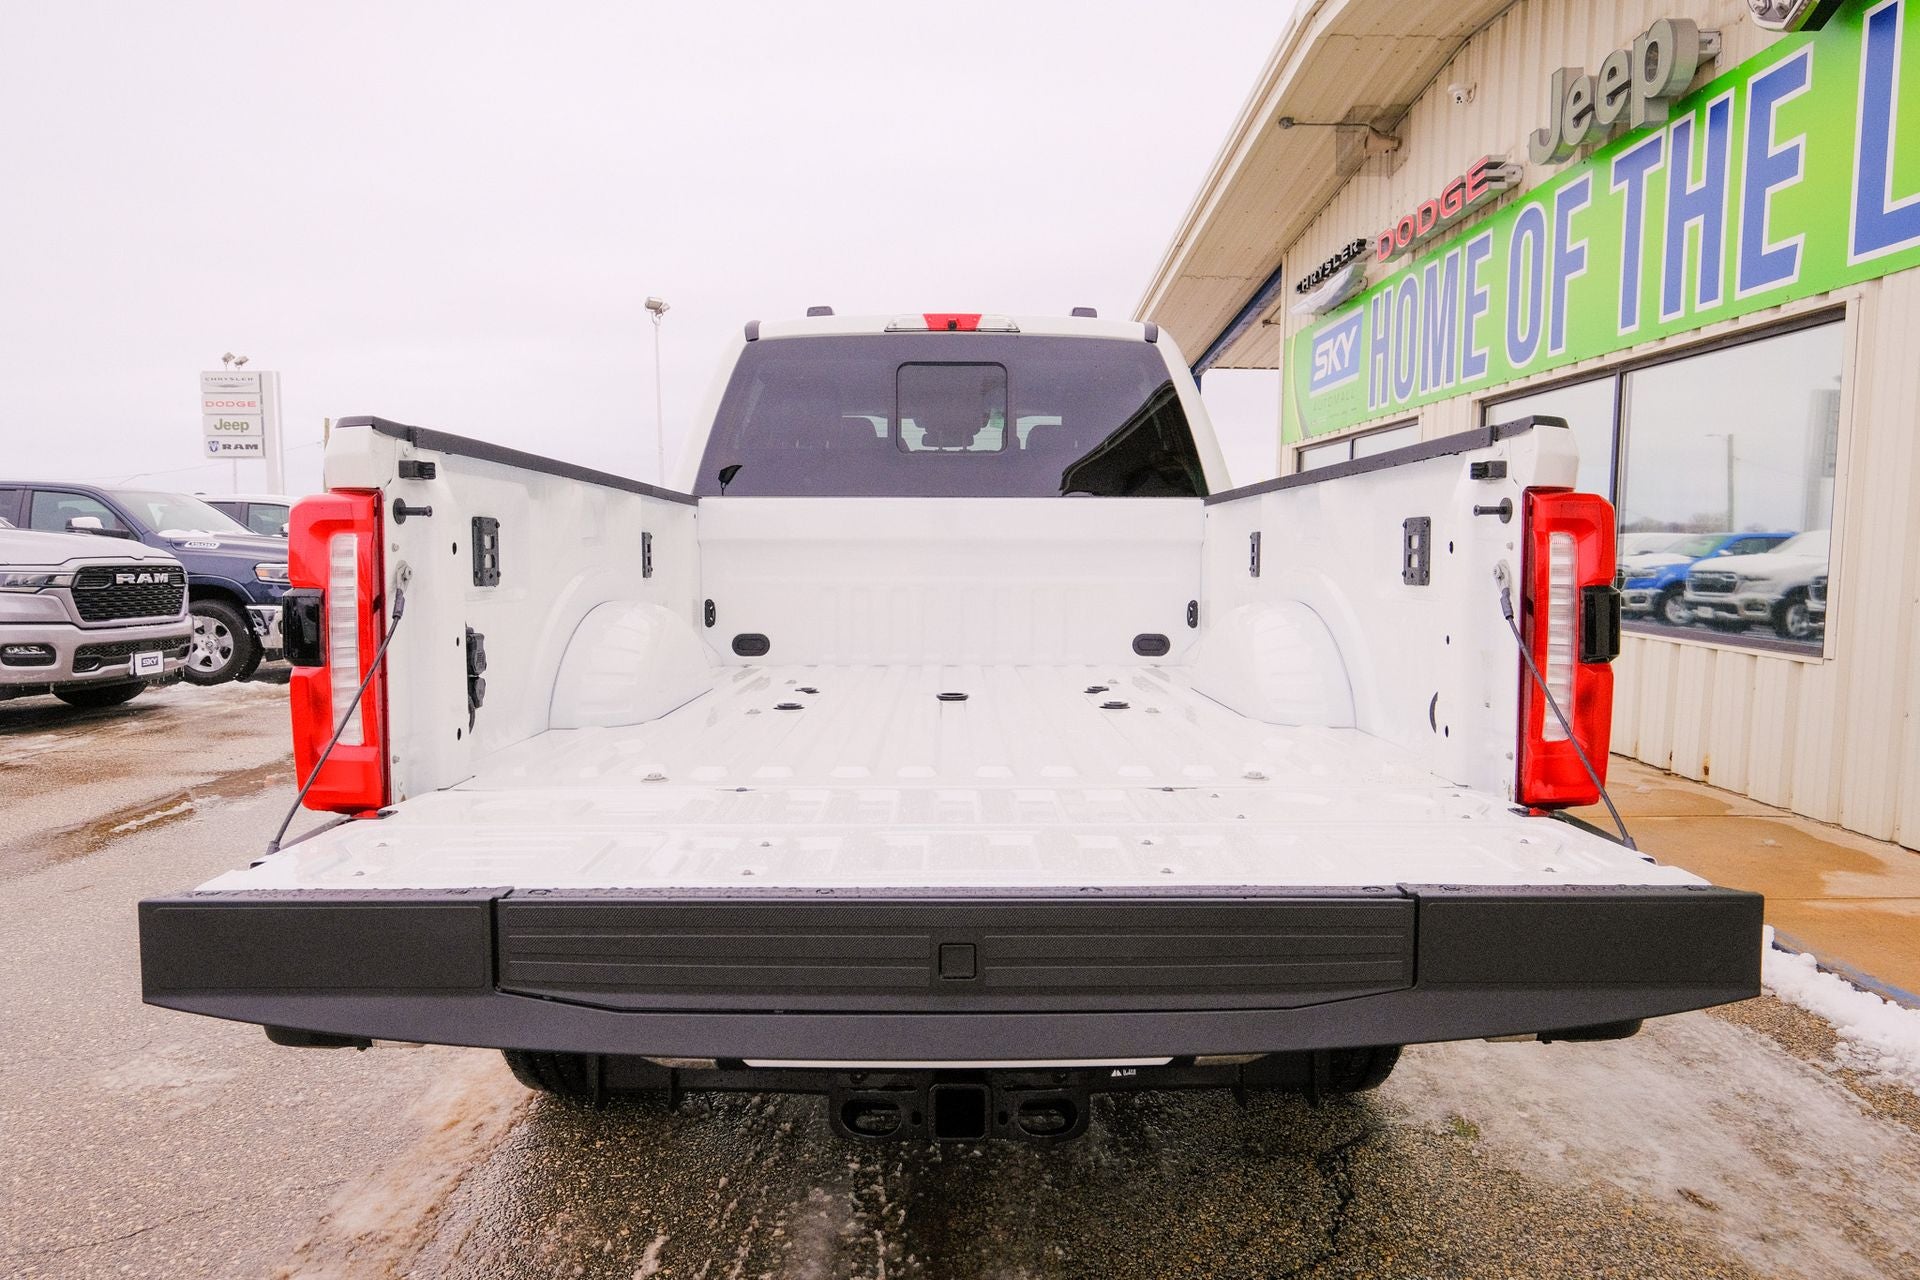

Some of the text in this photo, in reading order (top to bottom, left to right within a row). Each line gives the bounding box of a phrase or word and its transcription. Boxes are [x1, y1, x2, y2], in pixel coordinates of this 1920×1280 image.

[1529, 18, 1676, 166] Jeep
[1367, 227, 1494, 412] HOME
[1505, 169, 1594, 371] OF
[1608, 41, 1814, 337] THE
[1376, 155, 1490, 264] DODGE
[1296, 239, 1366, 294] CHRYSLER
[1313, 325, 1359, 382] SKY
[214, 418, 250, 433] Jeep
[116, 573, 169, 584] RAM
[142, 657, 159, 667] SKY
